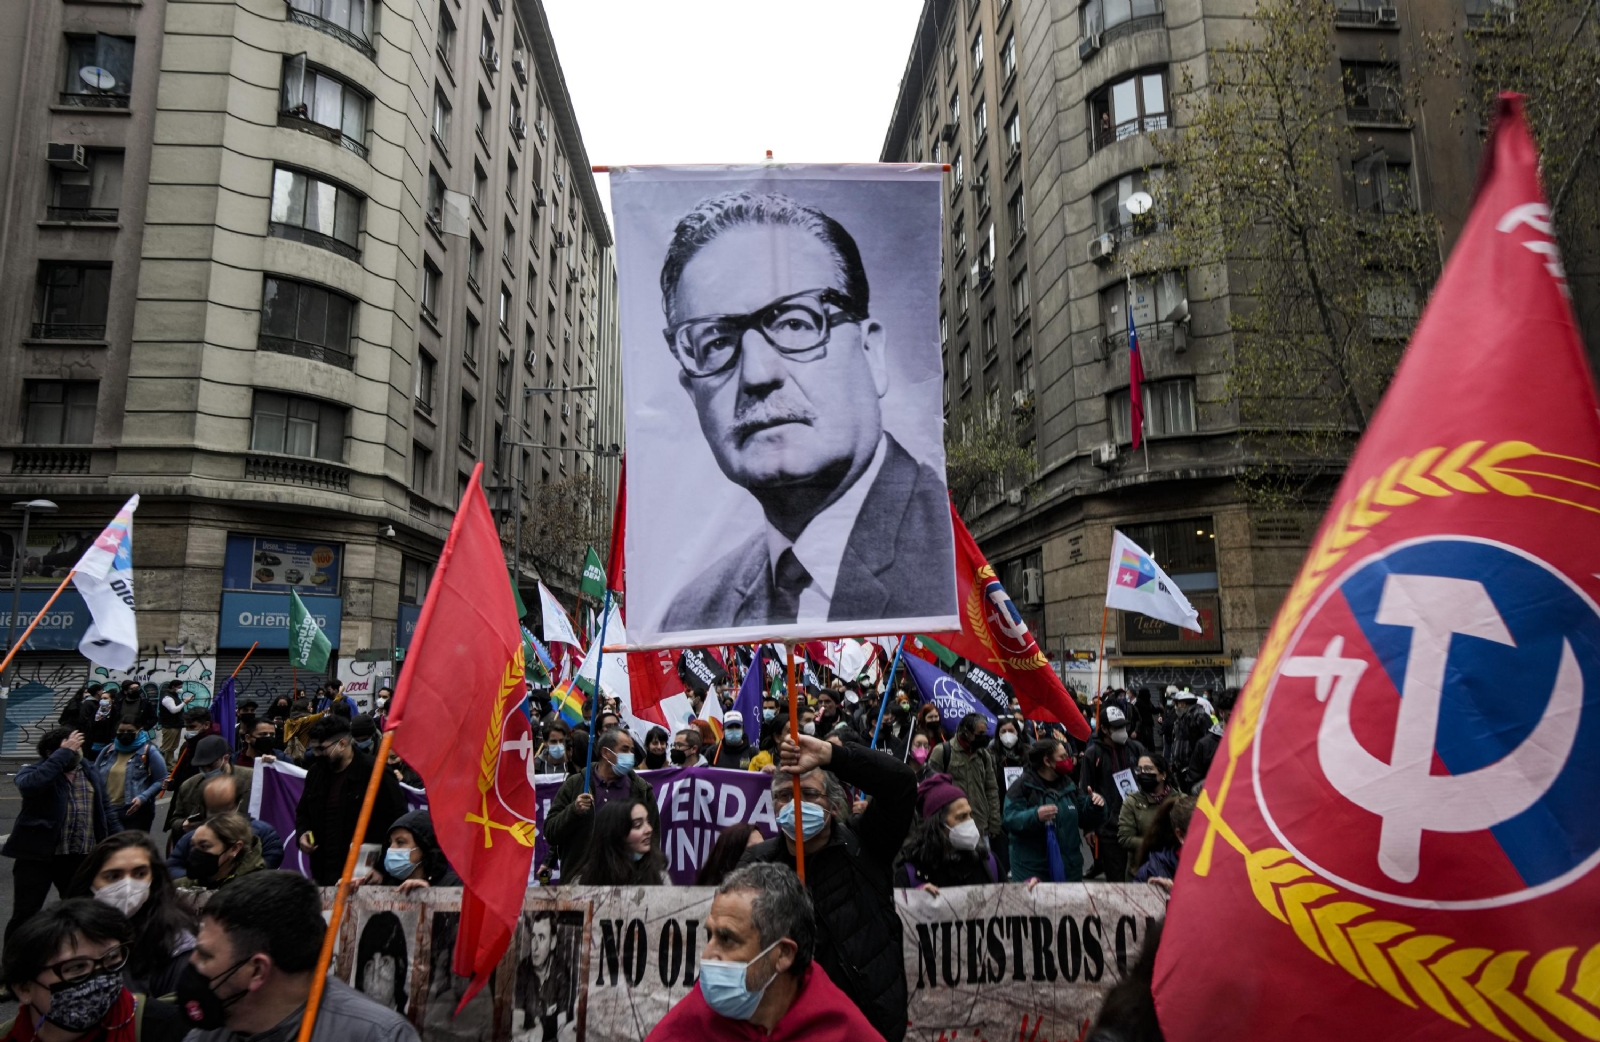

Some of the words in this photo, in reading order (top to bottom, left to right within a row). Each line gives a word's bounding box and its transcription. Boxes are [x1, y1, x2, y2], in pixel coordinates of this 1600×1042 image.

[317, 554, 331, 564] 100
[110, 579, 136, 612] DIG
[657, 777, 779, 833] VERDA
[596, 918, 647, 988] NO
[659, 918, 700, 988] OL
[916, 914, 1104, 989] NUESTROS
